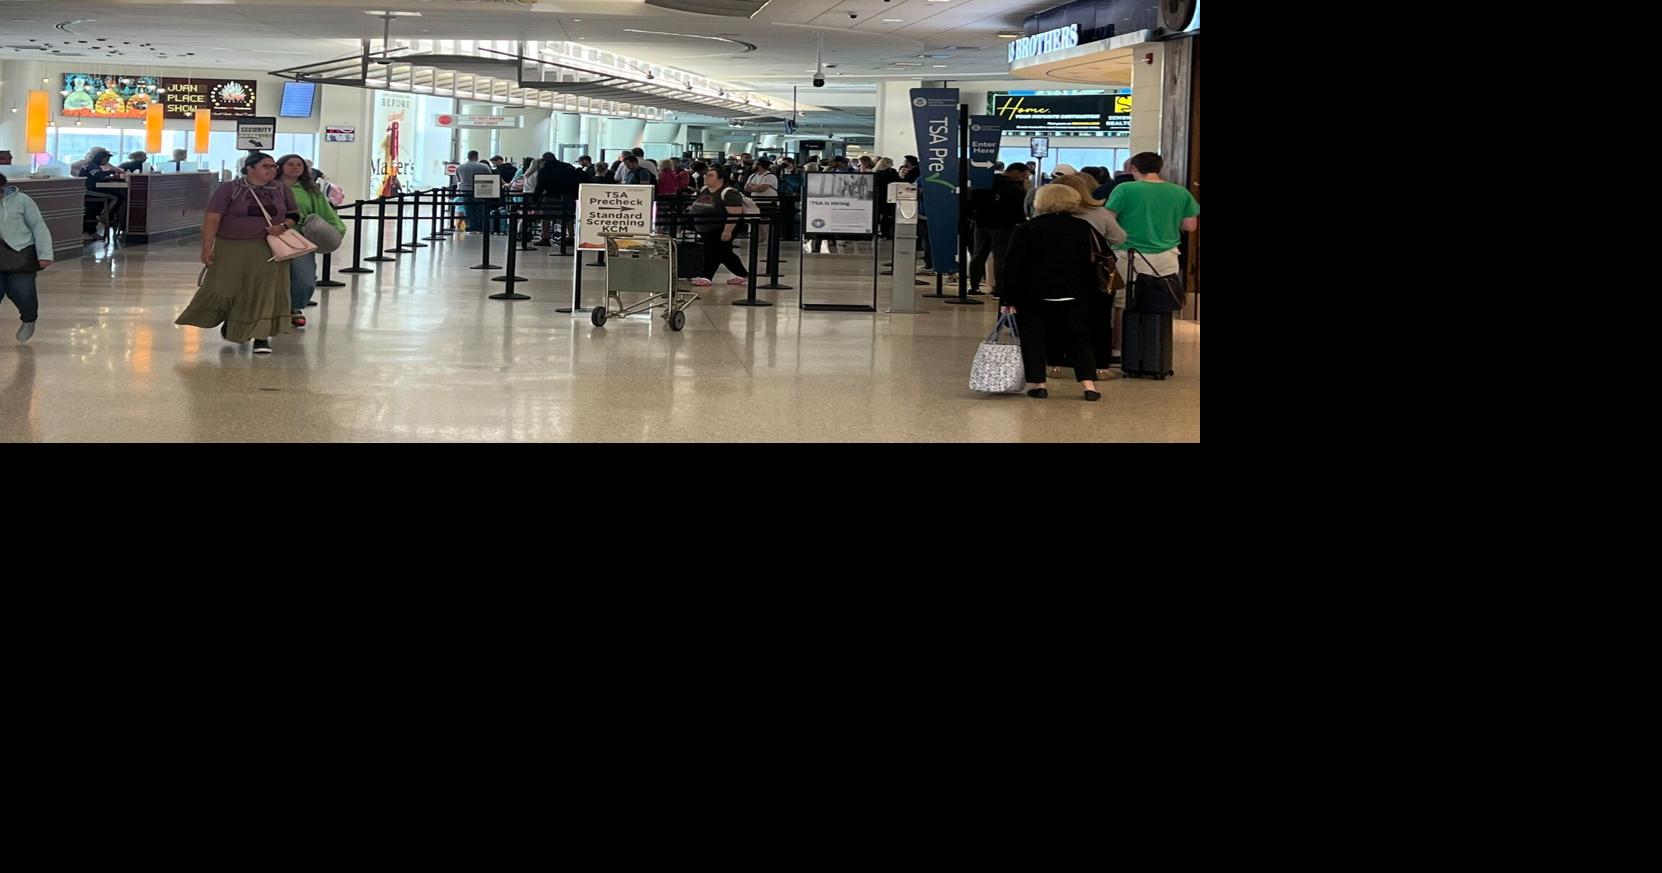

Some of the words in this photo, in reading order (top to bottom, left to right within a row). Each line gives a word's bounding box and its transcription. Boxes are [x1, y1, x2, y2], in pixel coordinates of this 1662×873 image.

[1015, 24, 1079, 59] BROTHERS
[167, 84, 198, 92] JUAN
[167, 94, 205, 103] PLACE
[381, 98, 411, 109] BEFORE
[167, 104, 198, 113] SHOW
[928, 116, 949, 145] TSA
[928, 148, 948, 172] Pre
[371, 158, 415, 177] Maer's
[605, 191, 629, 199] TSA
[589, 197, 643, 206] Precheck
[589, 211, 643, 220] Standard
[586, 218, 645, 228] Screening
[602, 225, 628, 233] KCM
